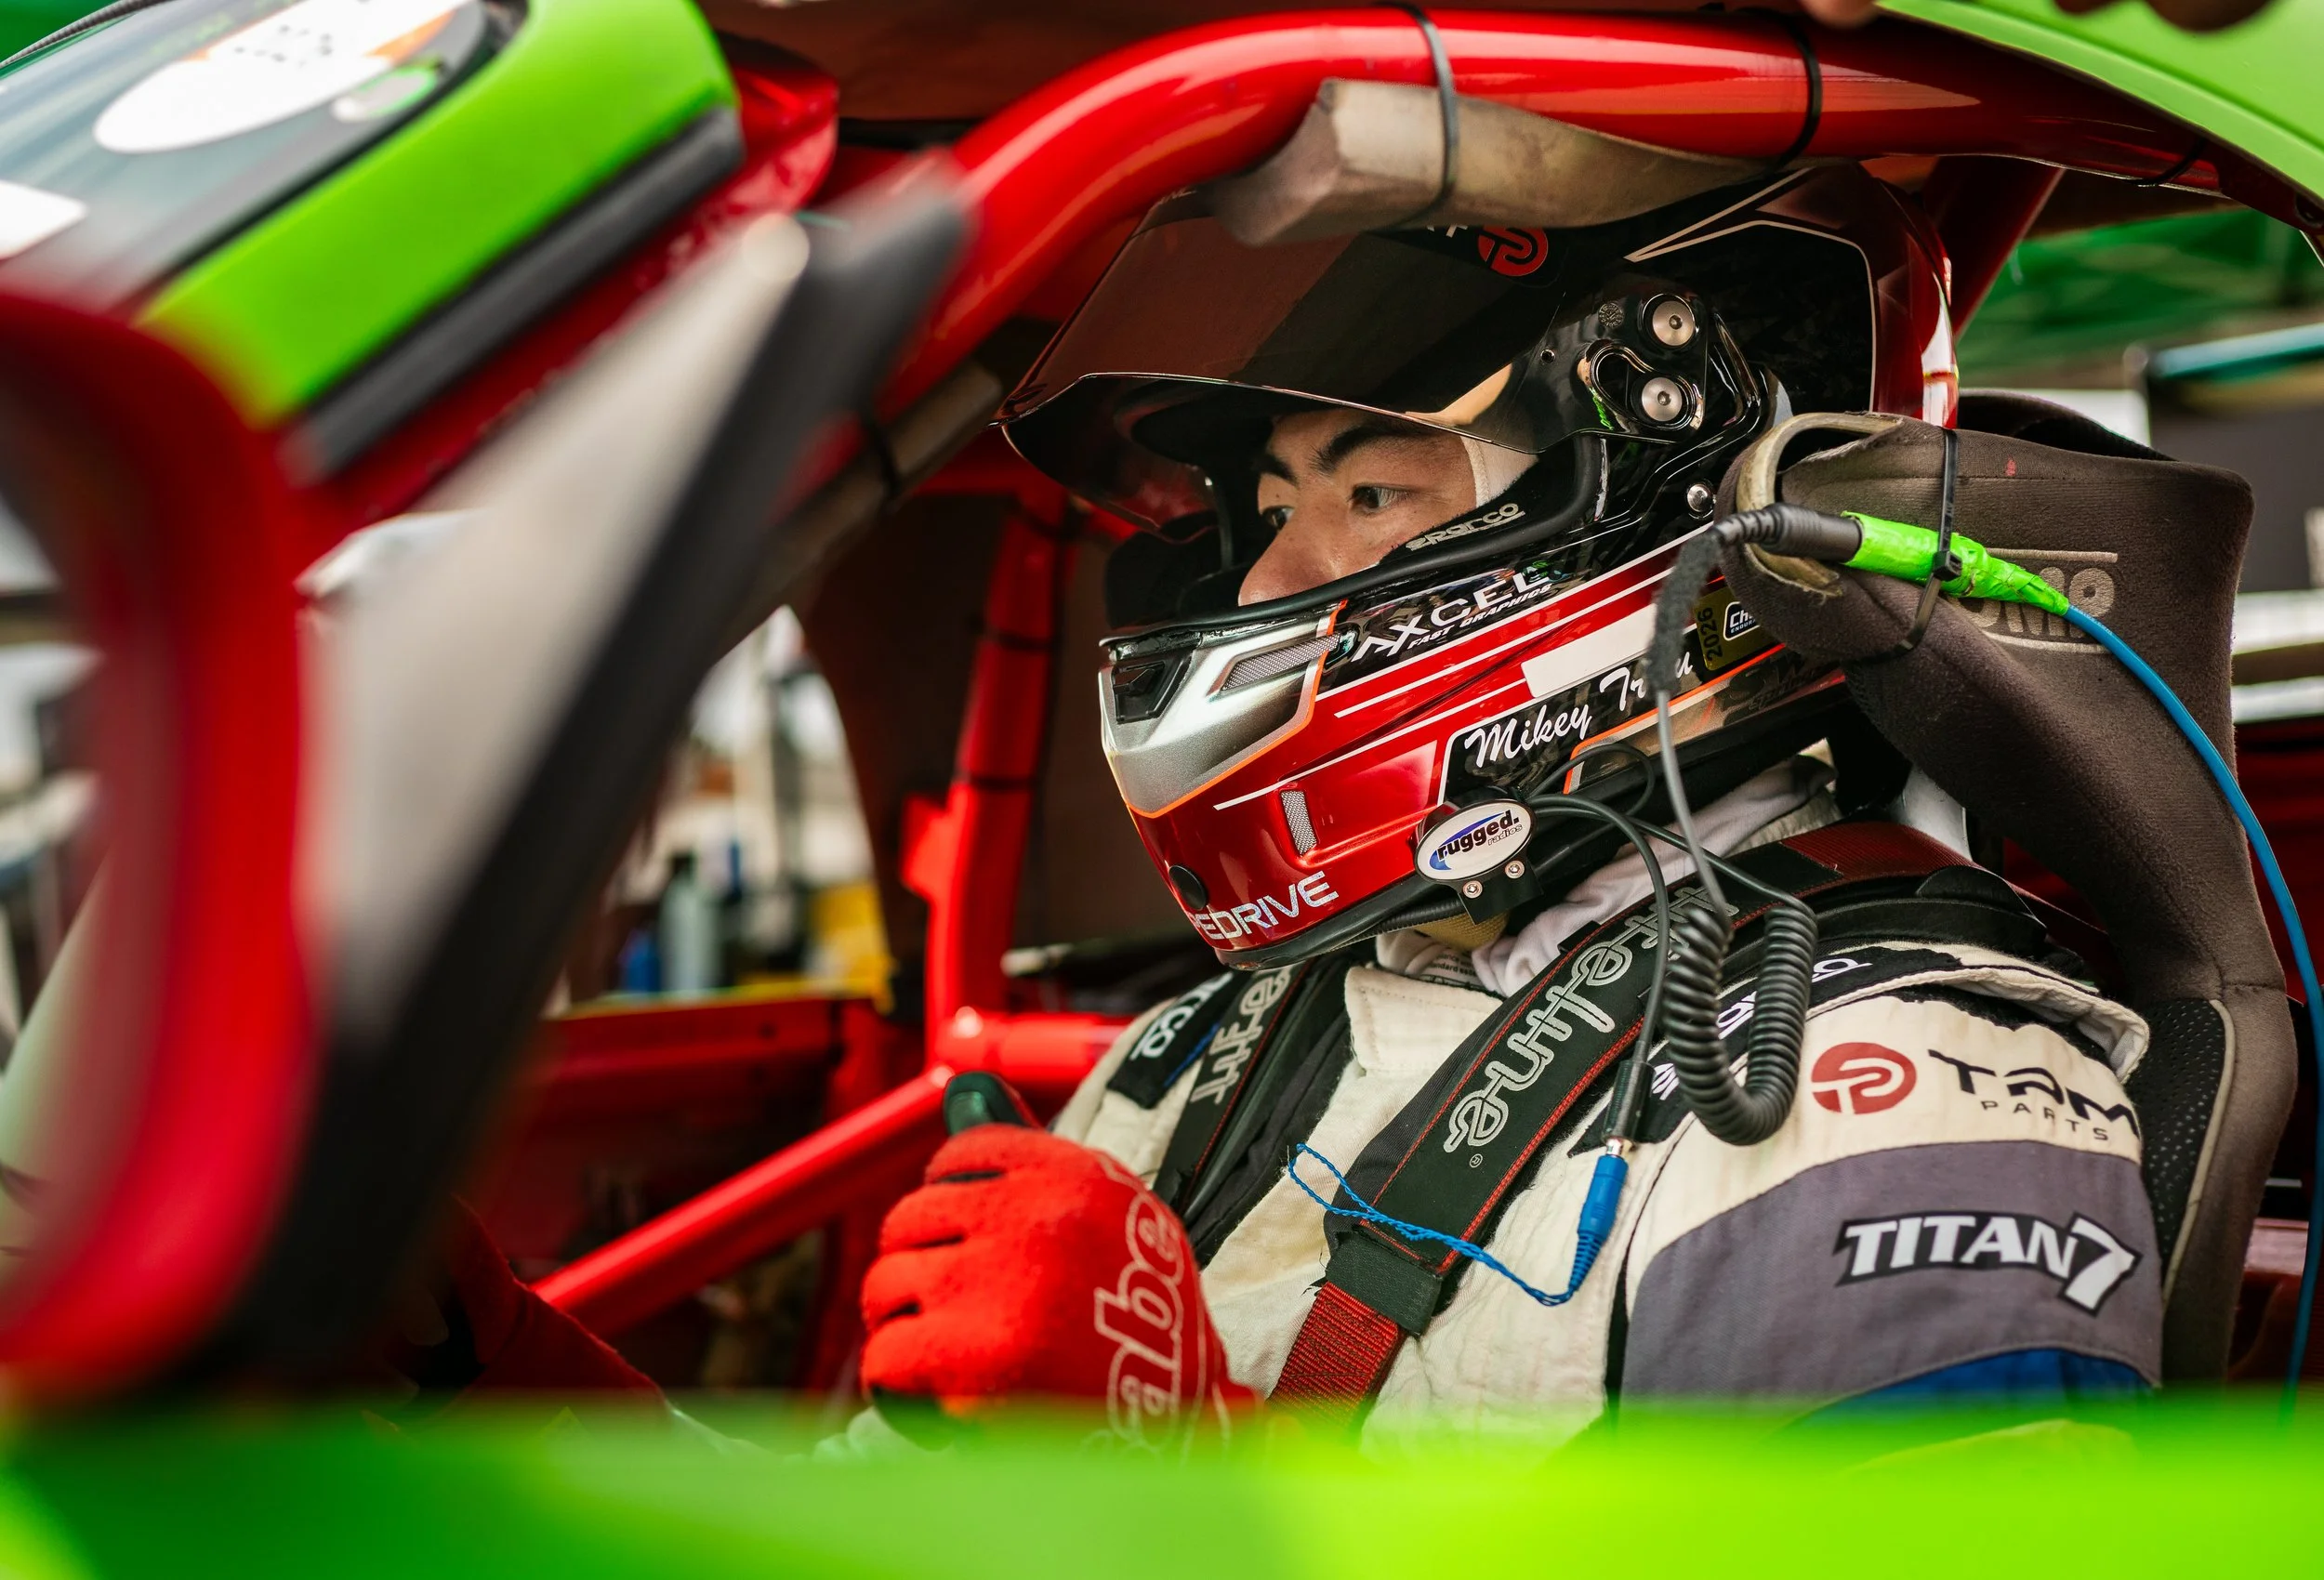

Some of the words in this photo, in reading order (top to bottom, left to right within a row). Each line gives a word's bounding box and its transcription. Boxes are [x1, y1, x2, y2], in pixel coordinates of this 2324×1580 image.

[1351, 572, 1550, 663] AXCEL
[1407, 625, 1455, 650] FAST
[1459, 583, 1552, 628] GRAPHICS
[1697, 607, 1723, 662] 2026
[1464, 704, 1592, 769] Mikey
[1487, 823, 1524, 846] radios
[1187, 870, 1340, 941] EDRIVE
[1927, 1048, 2141, 1139] TAM
[1980, 1099, 2109, 1141] PARTS
[1843, 1214, 2137, 1311] TITAN7
